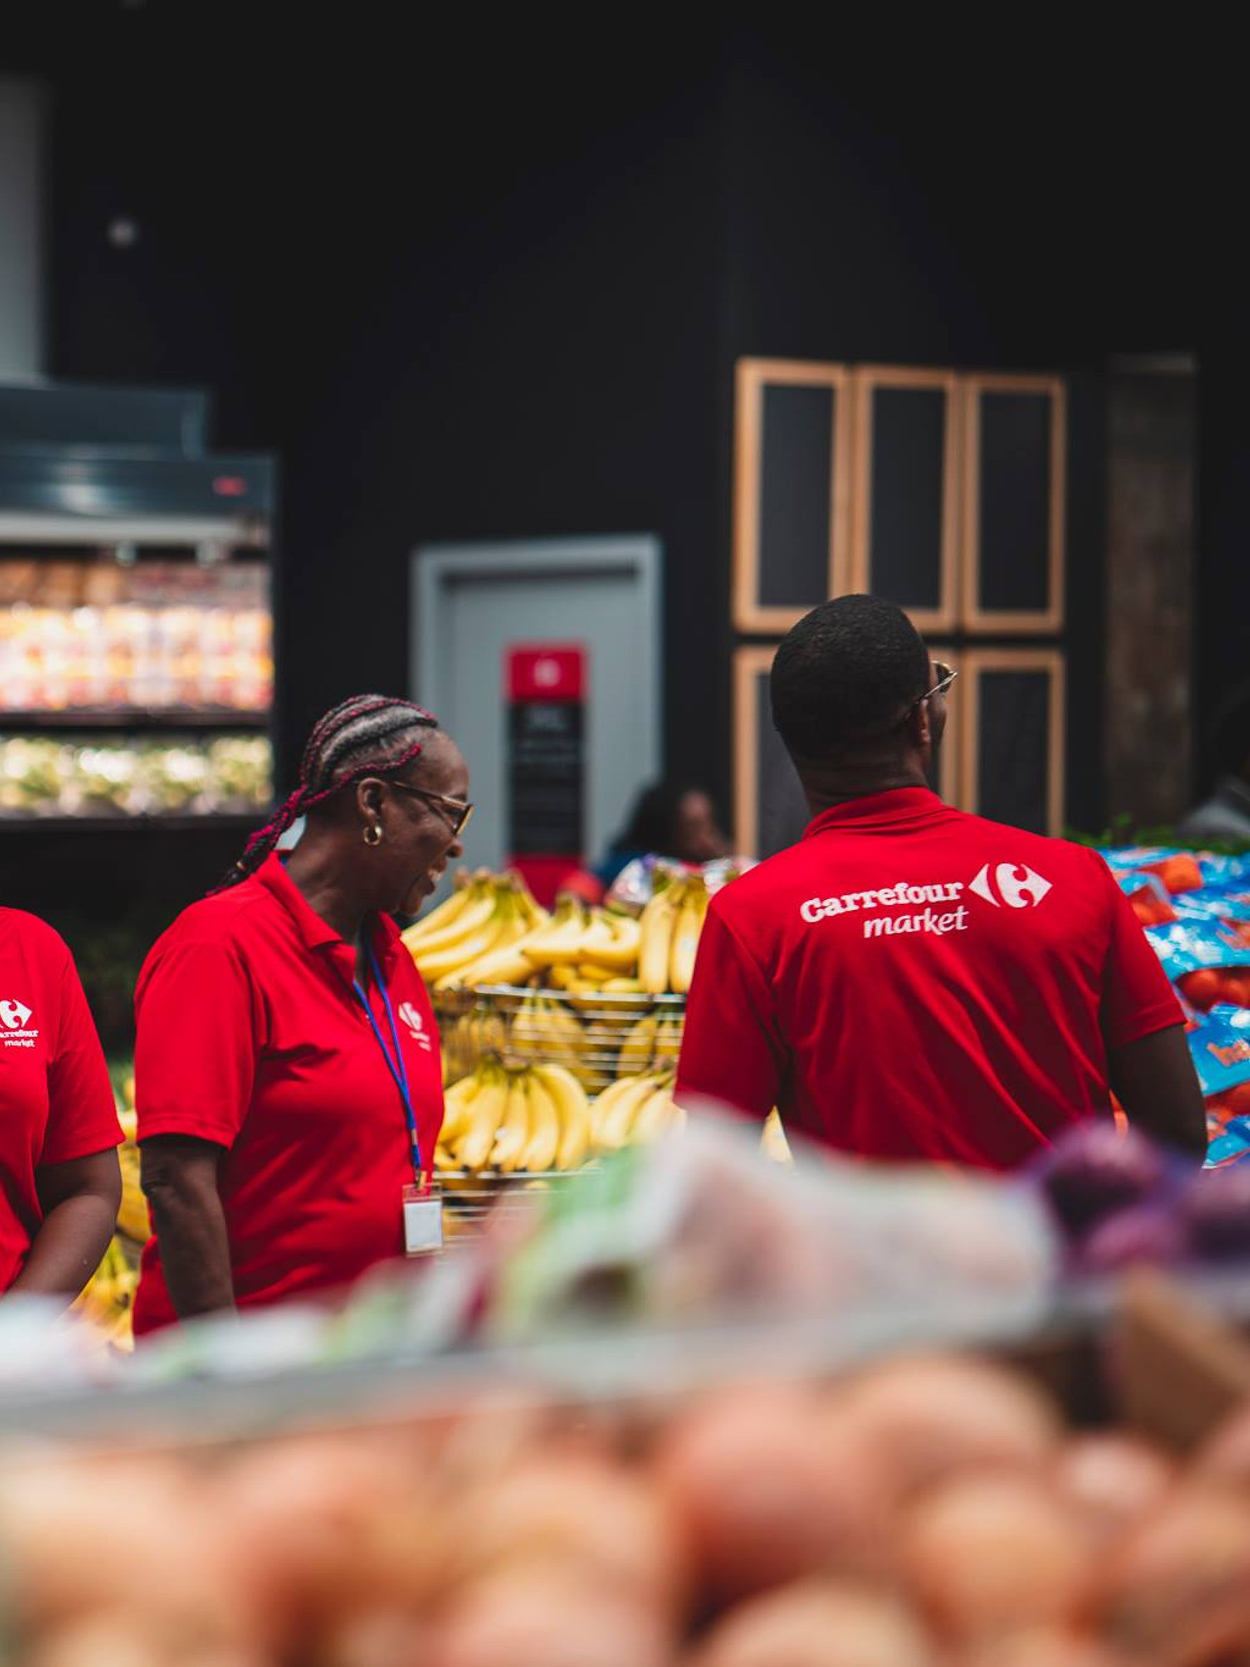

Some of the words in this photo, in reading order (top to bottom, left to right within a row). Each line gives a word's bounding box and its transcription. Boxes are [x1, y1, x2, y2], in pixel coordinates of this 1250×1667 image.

[800, 882, 964, 923] Carrefour
[863, 905, 970, 938] market
[4, 1039, 36, 1048] market
